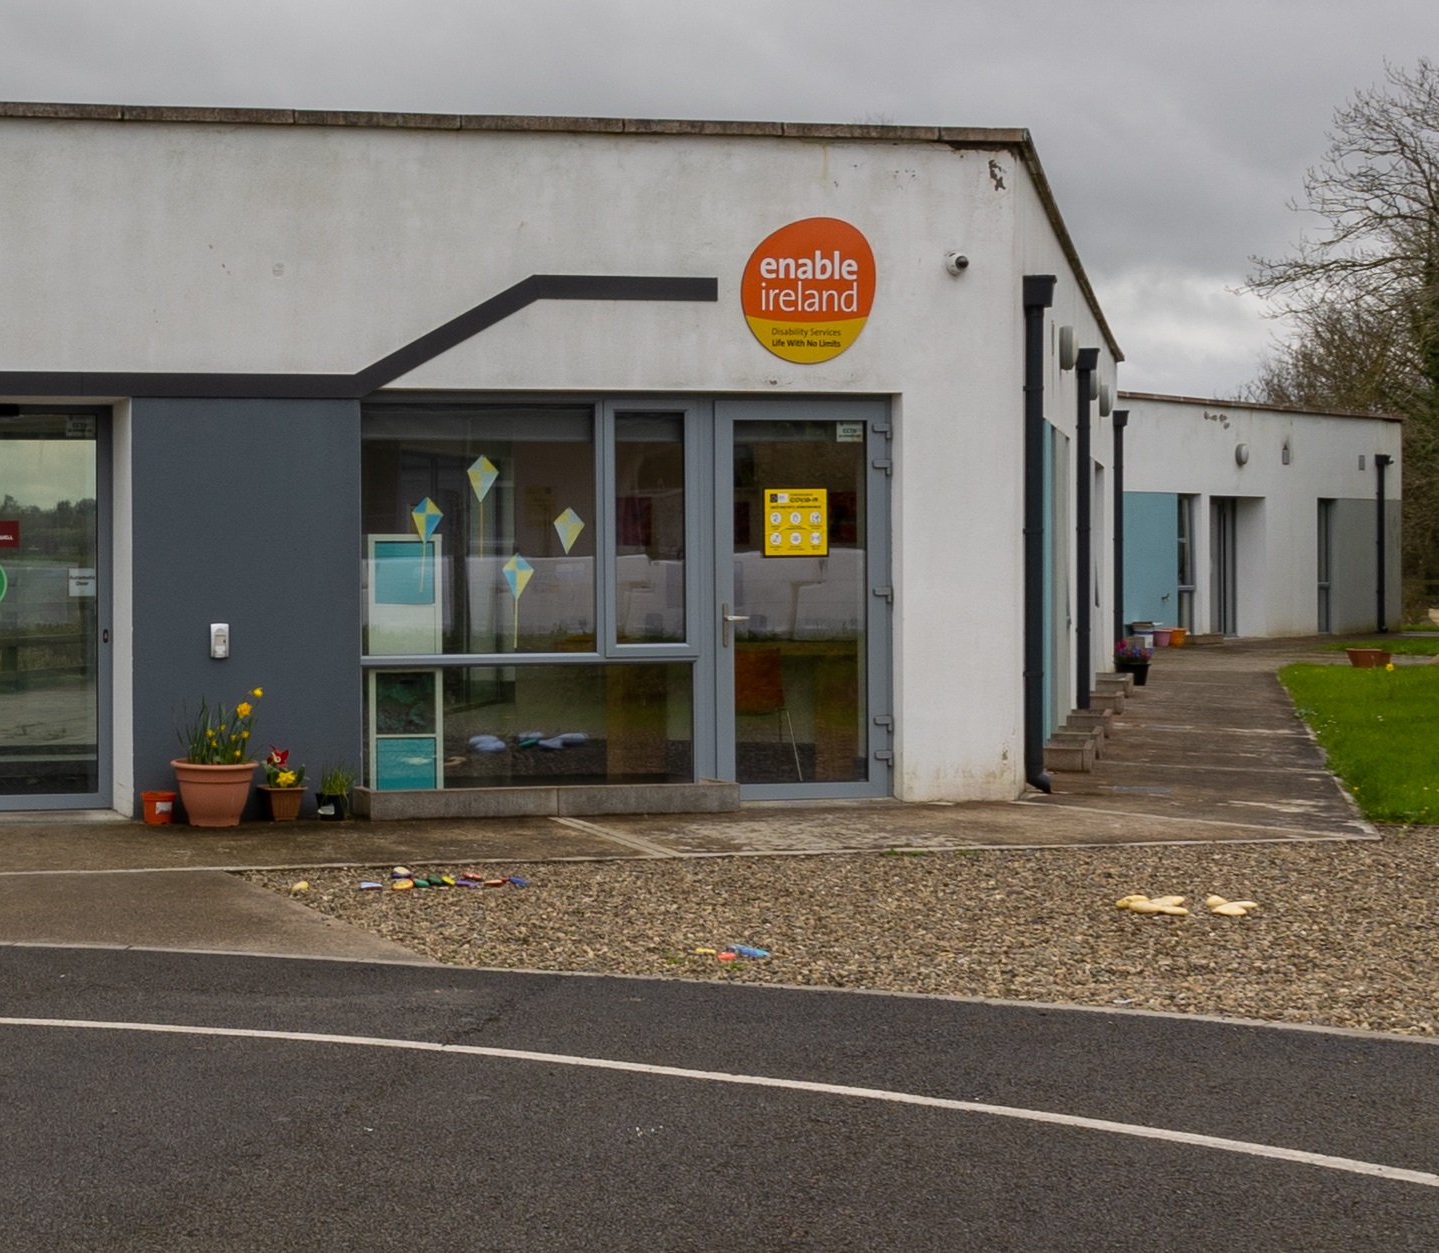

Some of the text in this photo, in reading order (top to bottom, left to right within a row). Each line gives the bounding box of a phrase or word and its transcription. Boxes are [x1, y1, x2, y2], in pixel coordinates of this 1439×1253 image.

[760, 250, 858, 280] enable
[761, 281, 857, 312] ireland
[772, 328, 841, 338] Disability Services
[772, 339, 841, 348] Life With No Limits
